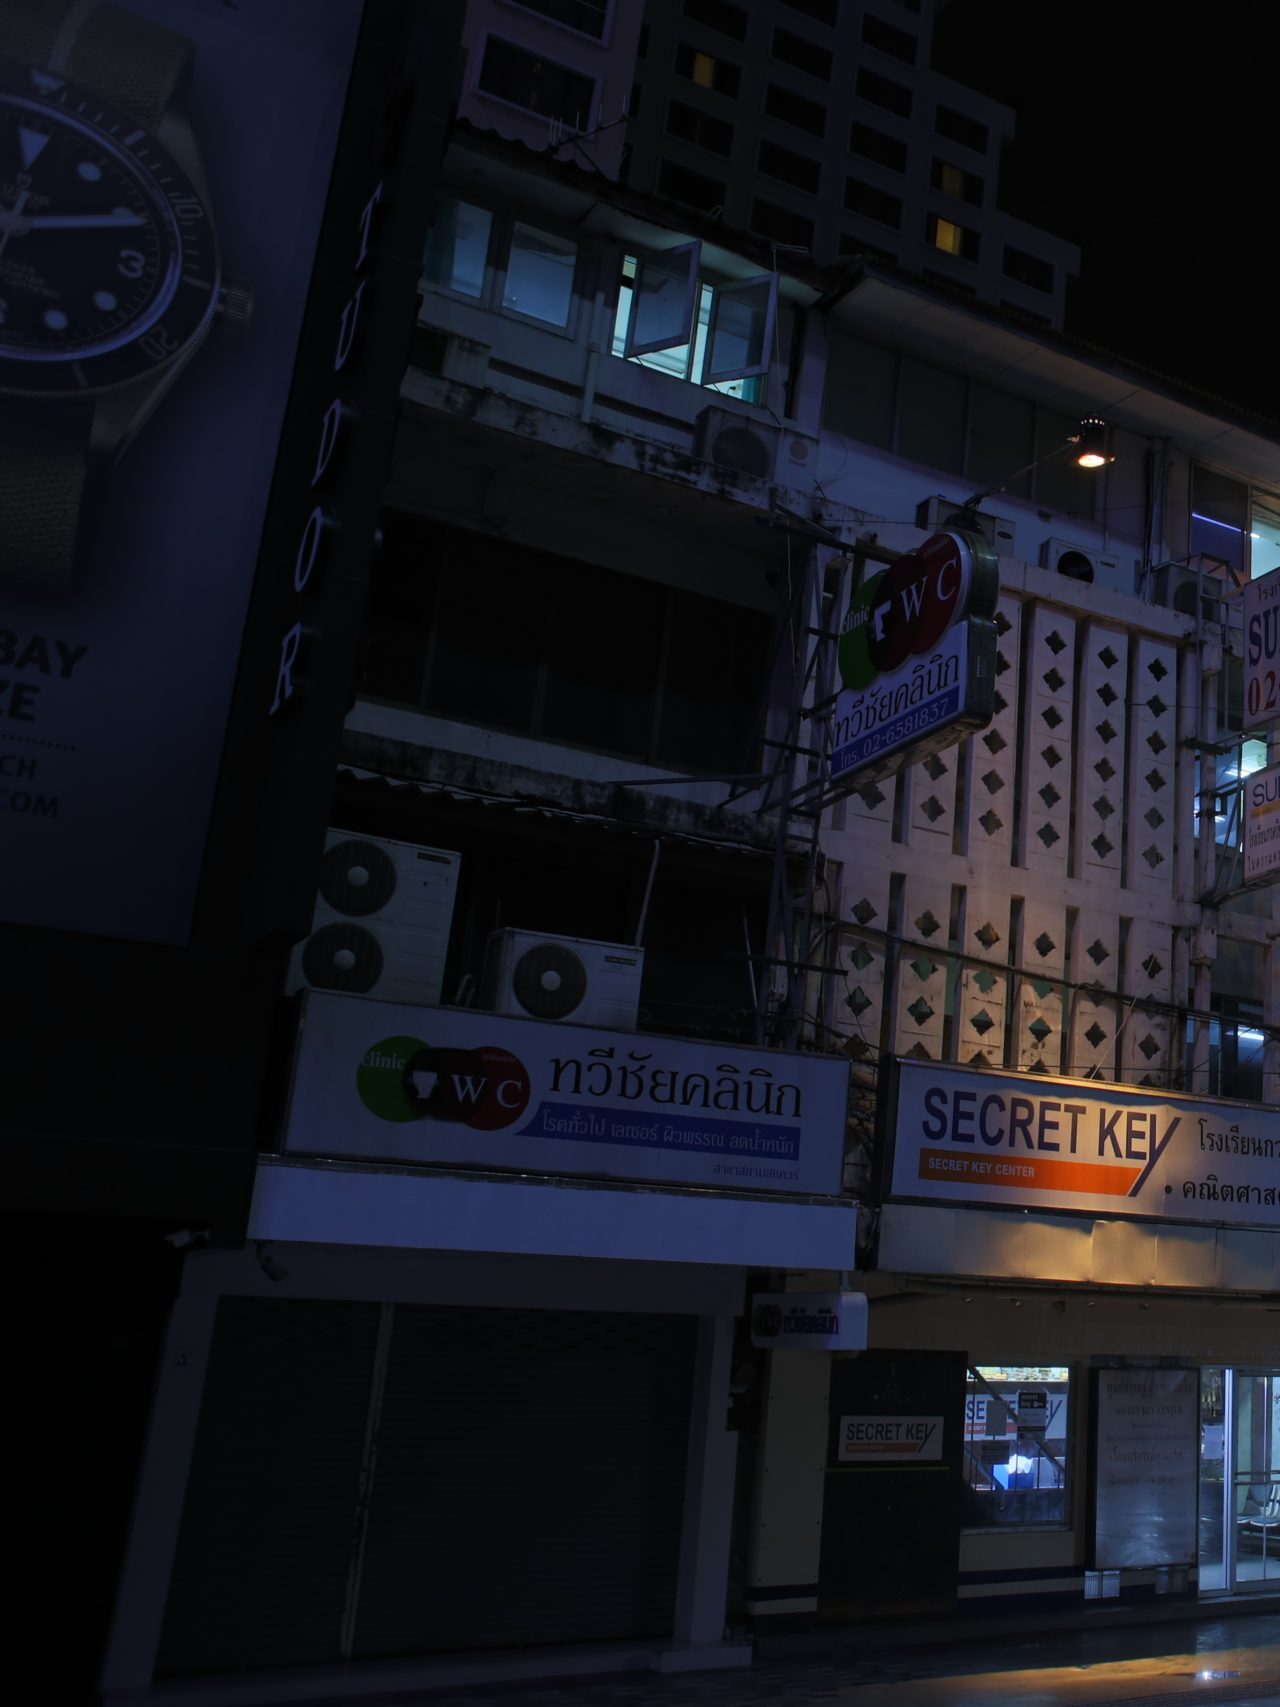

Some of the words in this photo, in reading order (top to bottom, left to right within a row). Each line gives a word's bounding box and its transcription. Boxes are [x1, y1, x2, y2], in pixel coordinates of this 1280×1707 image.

[116, 249, 147, 280] 3
[268, 180, 385, 719] TUDOR
[835, 653, 959, 748] ทวีชัยคลินิก
[863, 697, 950, 757] 02-6581837
[550, 1047, 802, 1117] ทวีชัยคลินิก
[542, 1109, 606, 1137] โรคทั่วไป
[610, 1121, 660, 1143] เลเซอร์
[663, 1124, 726, 1148] ผิวพรรณ
[729, 1127, 795, 1154] ลดน้ำหนัก
[922, 1086, 1088, 1154] SECRET
[1097, 1106, 1182, 1198] KEY
[928, 1158, 969, 1172] SECRET
[971, 1160, 992, 1174] KEY
[995, 1163, 1036, 1178] CENTER
[846, 1422, 902, 1441] SECRET
[905, 1422, 938, 1454] KEY
